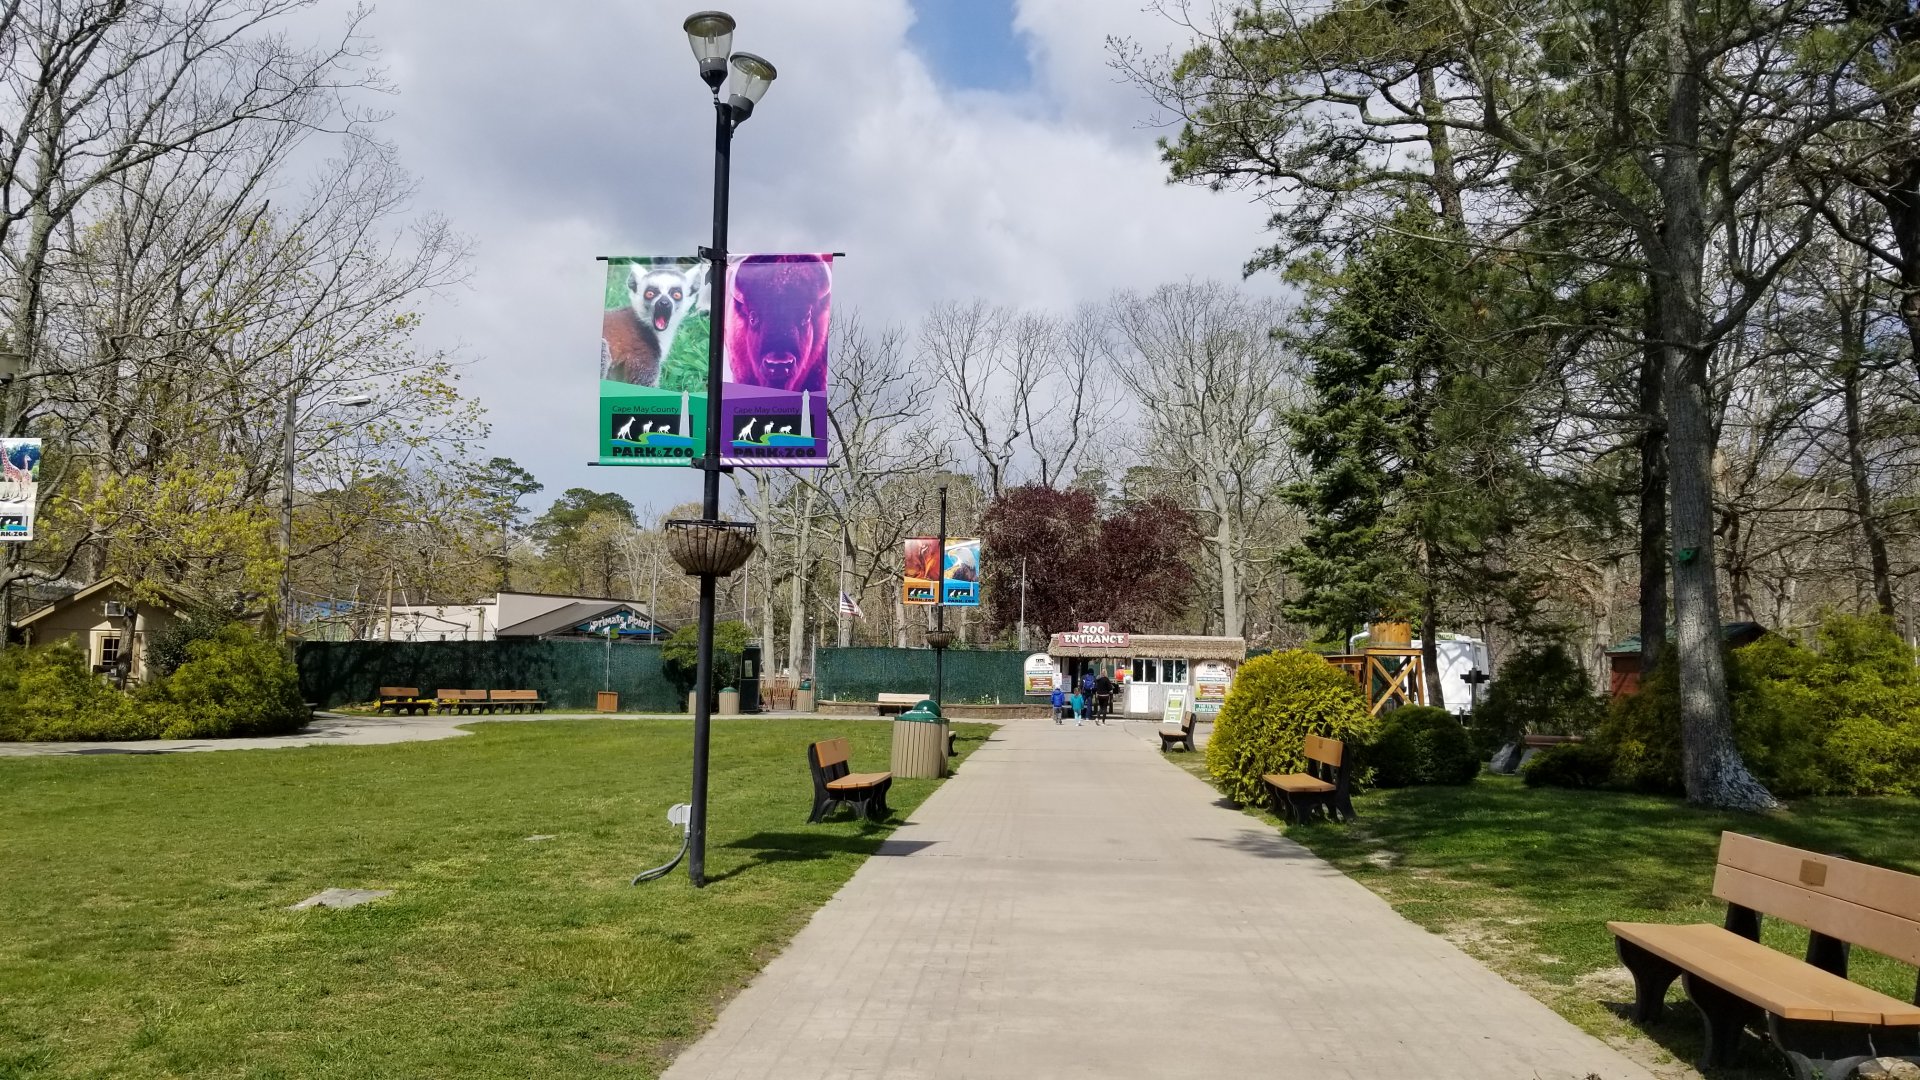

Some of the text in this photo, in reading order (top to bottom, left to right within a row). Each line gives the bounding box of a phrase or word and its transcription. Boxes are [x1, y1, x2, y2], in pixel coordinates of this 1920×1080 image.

[612, 405, 632, 413] Cape
[651, 405, 679, 413] County
[733, 406, 800, 414] Cape May County
[628, 615, 651, 629] Point
[1082, 625, 1106, 634] ZOO
[1063, 634, 1124, 644] ENTRANCE
